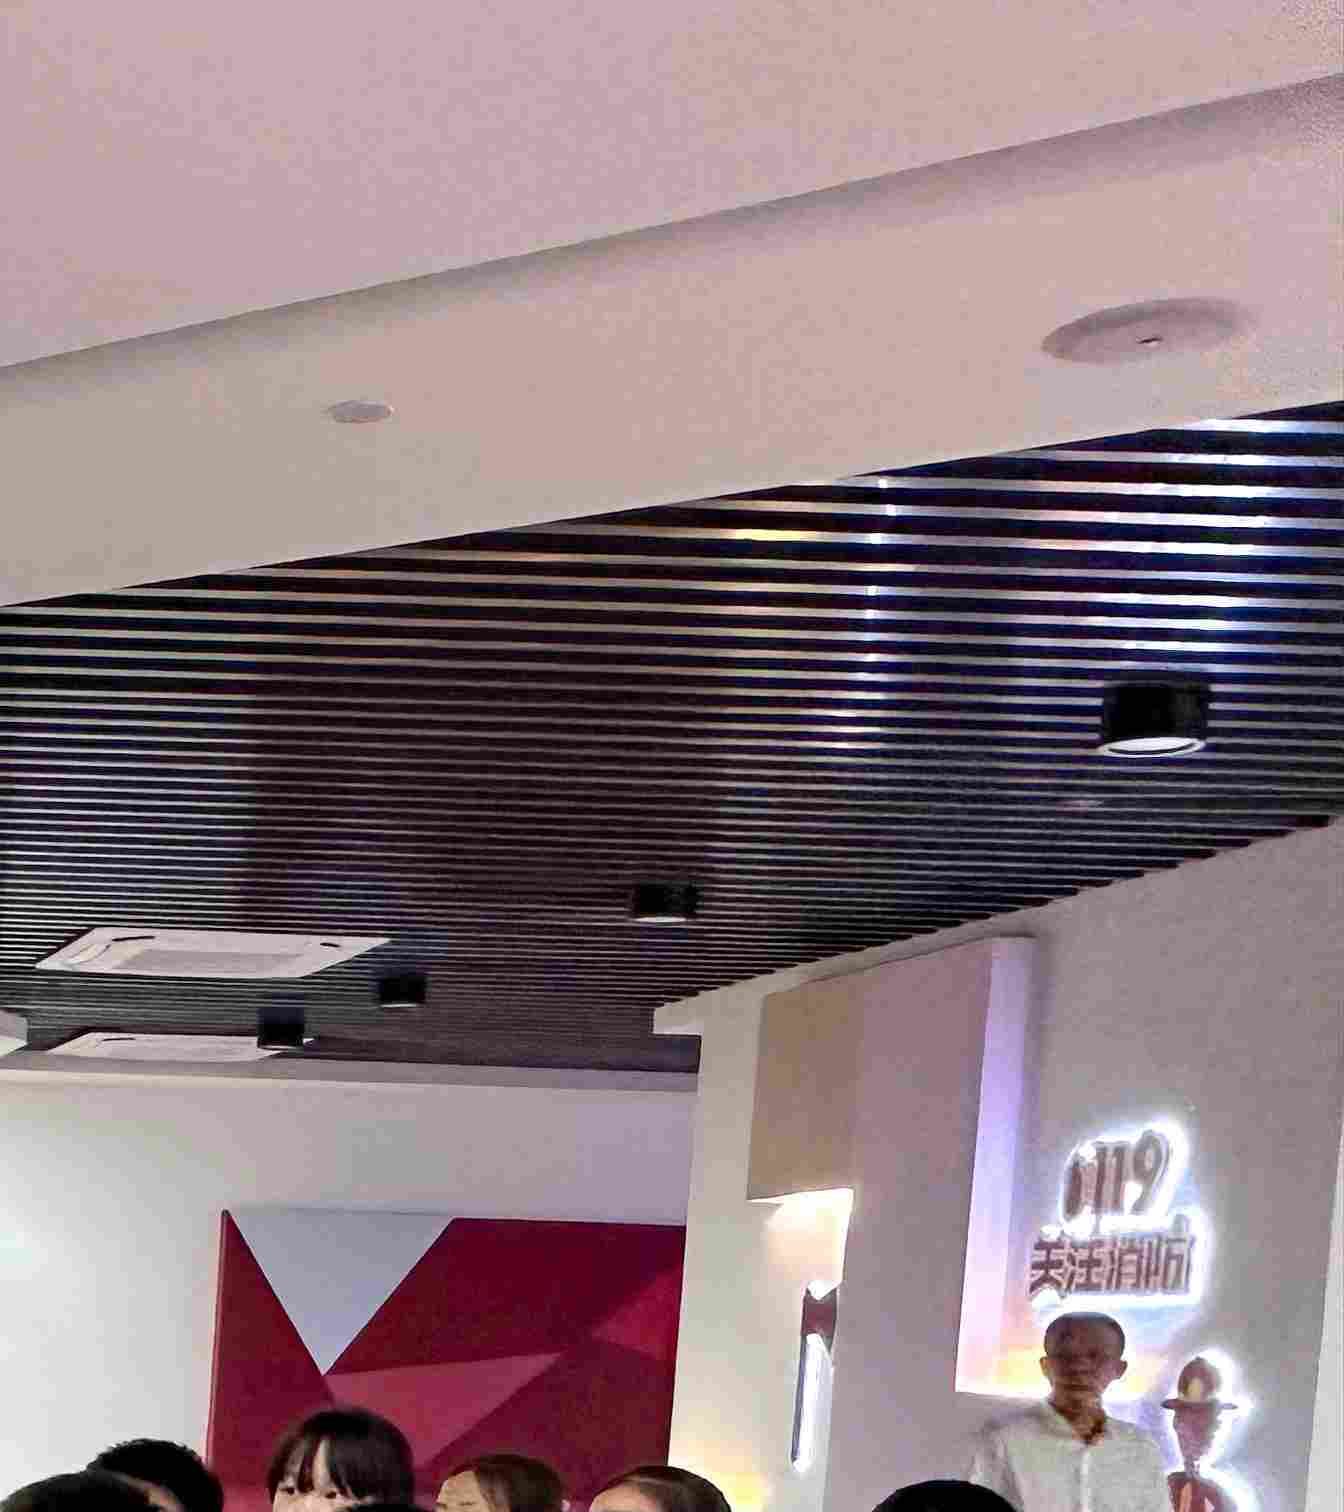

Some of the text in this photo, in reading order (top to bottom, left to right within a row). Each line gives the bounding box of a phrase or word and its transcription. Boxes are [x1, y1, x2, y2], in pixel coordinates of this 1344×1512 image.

[1063, 1130, 1171, 1219] 119
[1028, 1214, 1198, 1299] 关注消防
